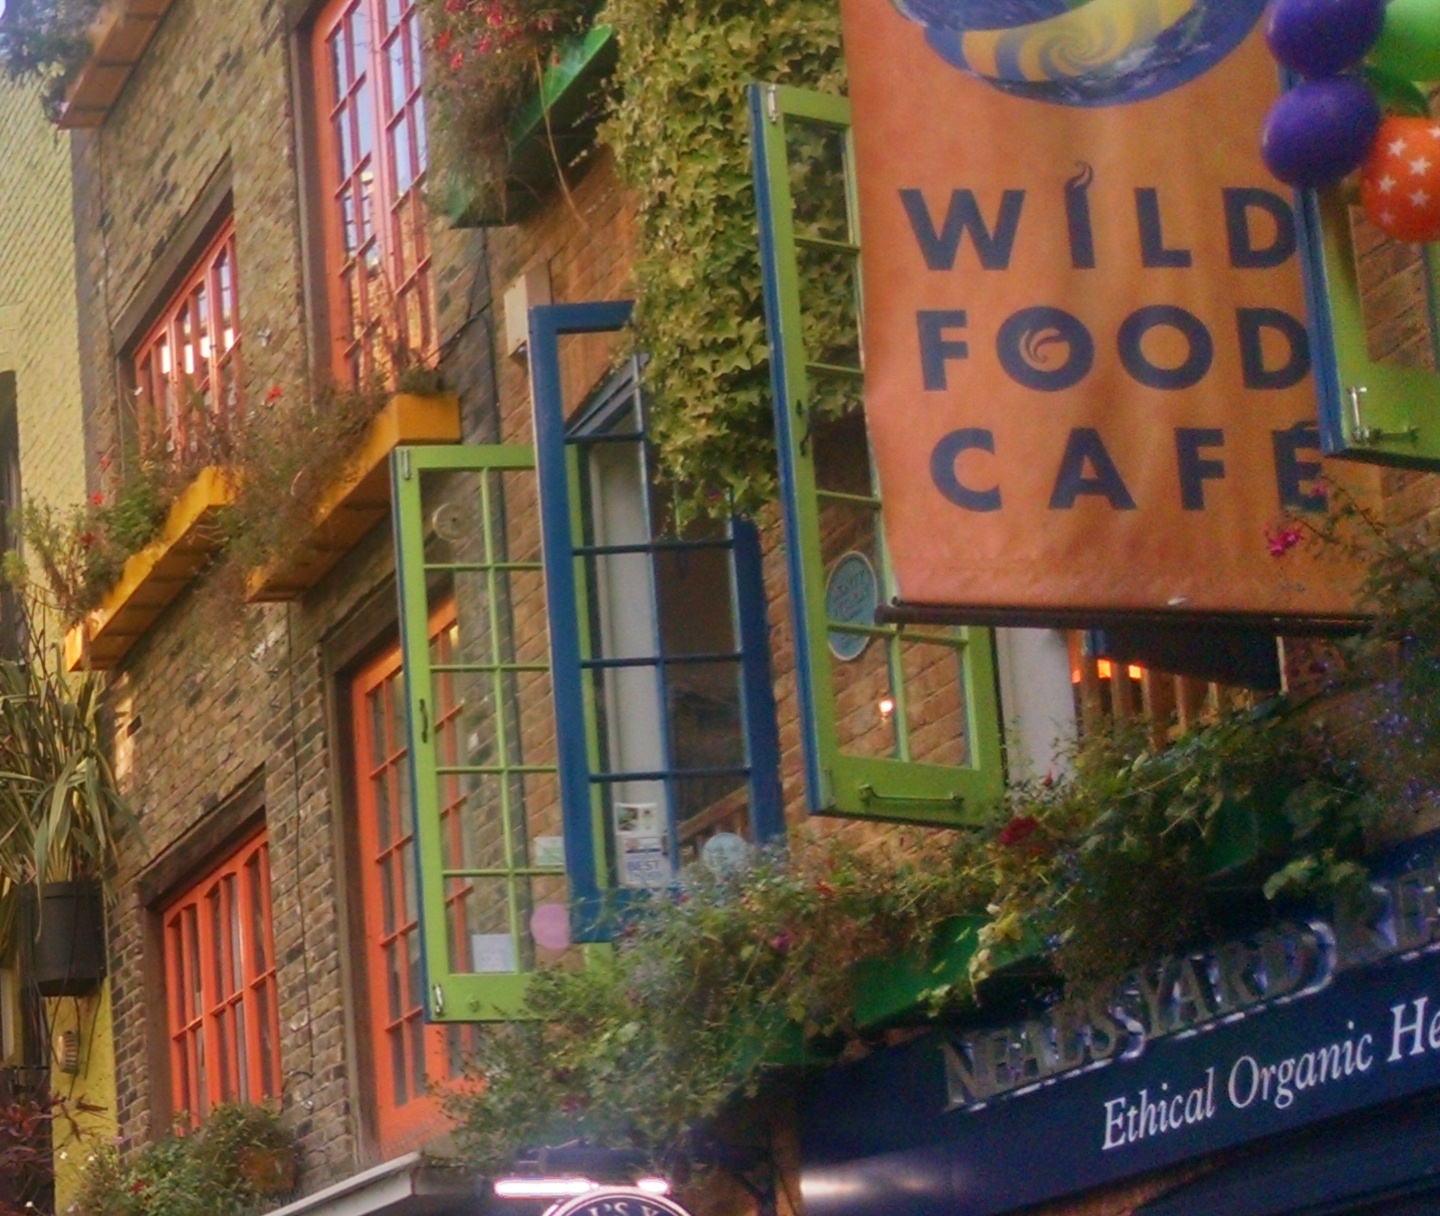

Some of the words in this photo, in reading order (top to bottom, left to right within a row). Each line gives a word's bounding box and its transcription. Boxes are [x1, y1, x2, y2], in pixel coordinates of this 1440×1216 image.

[898, 161, 1298, 271] WILD
[916, 305, 1310, 392] FOOD
[1102, 1068, 1215, 1151] Ethical
[1228, 1034, 1373, 1108] Organic
